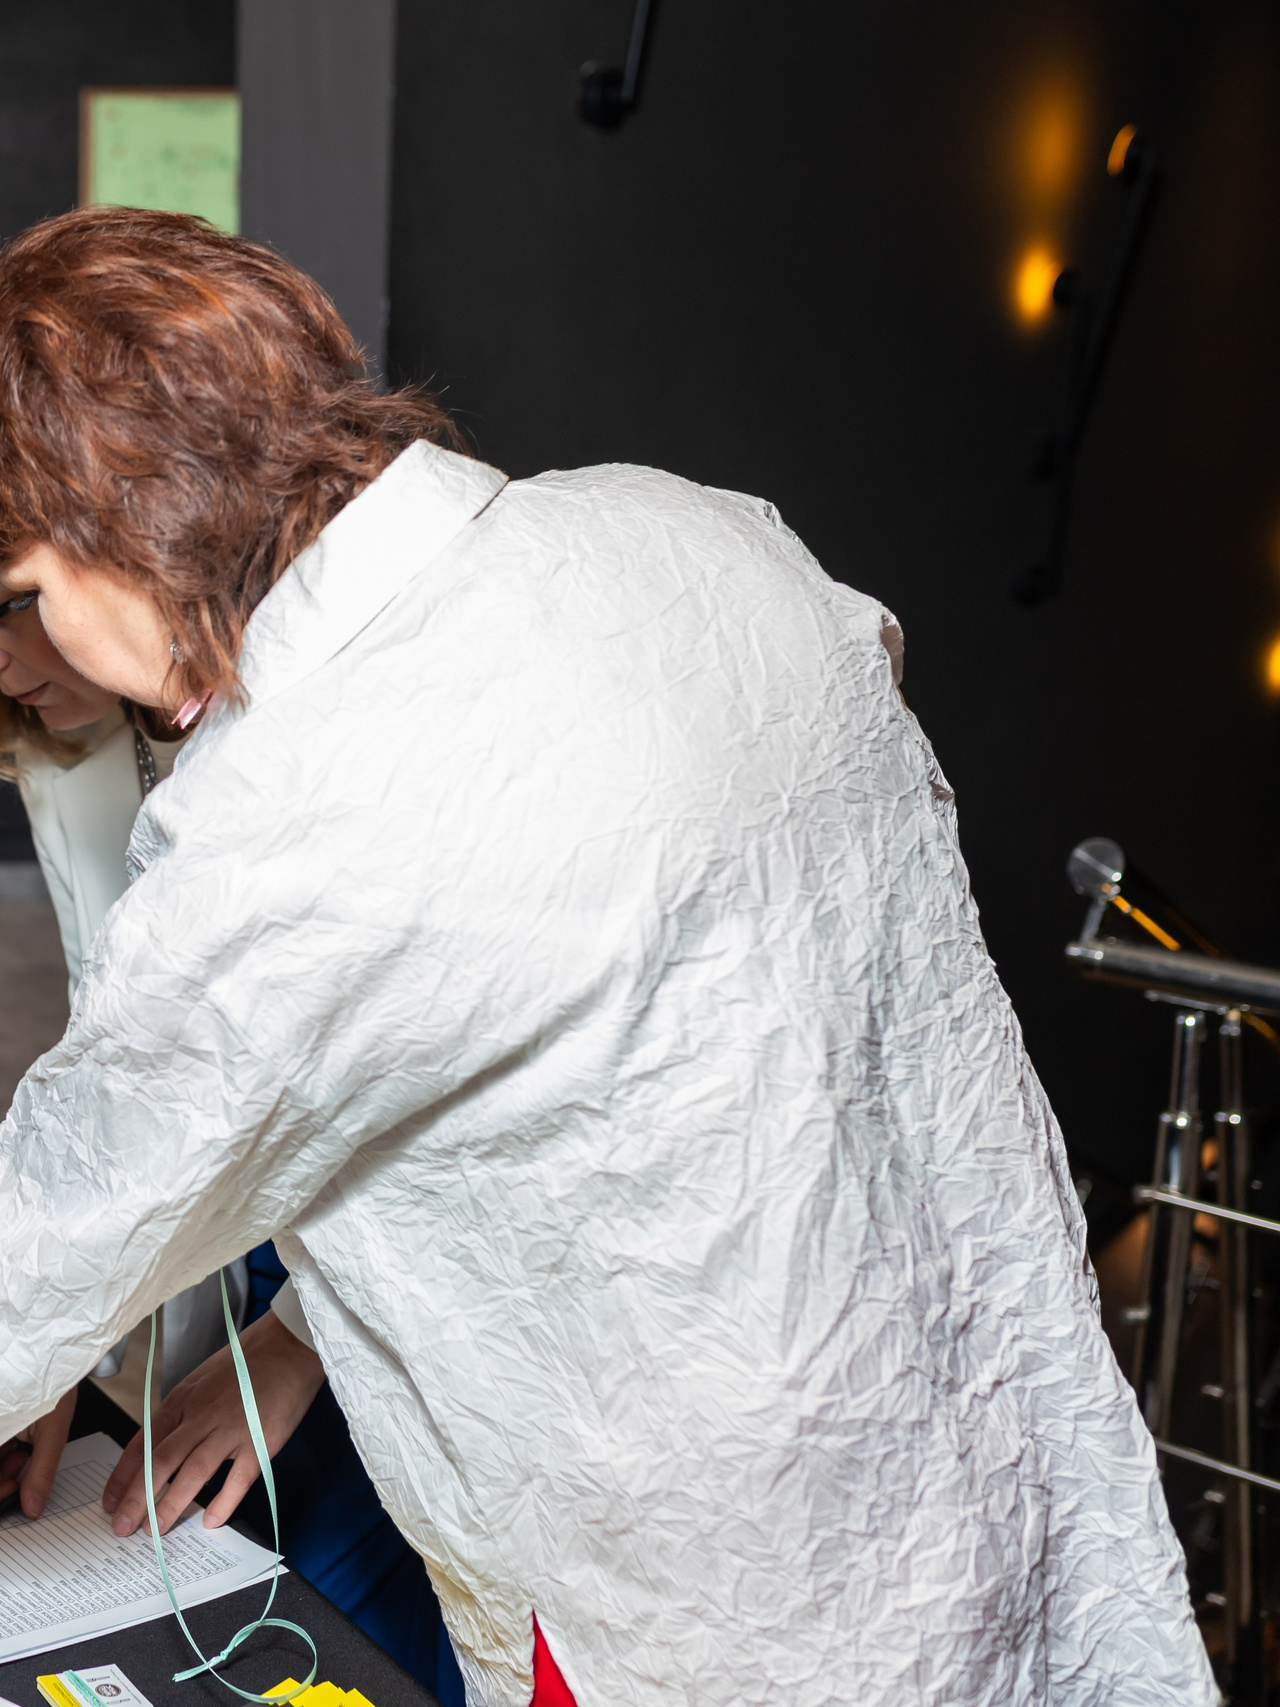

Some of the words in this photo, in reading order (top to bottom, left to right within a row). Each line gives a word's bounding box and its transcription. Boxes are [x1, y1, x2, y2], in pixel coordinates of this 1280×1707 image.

[168, 1565, 193, 1581] Татьяна
[177, 1561, 204, 1578] Татьяна
[72, 1602, 91, 1614] Ольга
[82, 1599, 102, 1611] Ольга
[92, 1596, 112, 1608] Ольга
[51, 1608, 70, 1620] Ольга
[61, 1605, 80, 1617] Ольга
